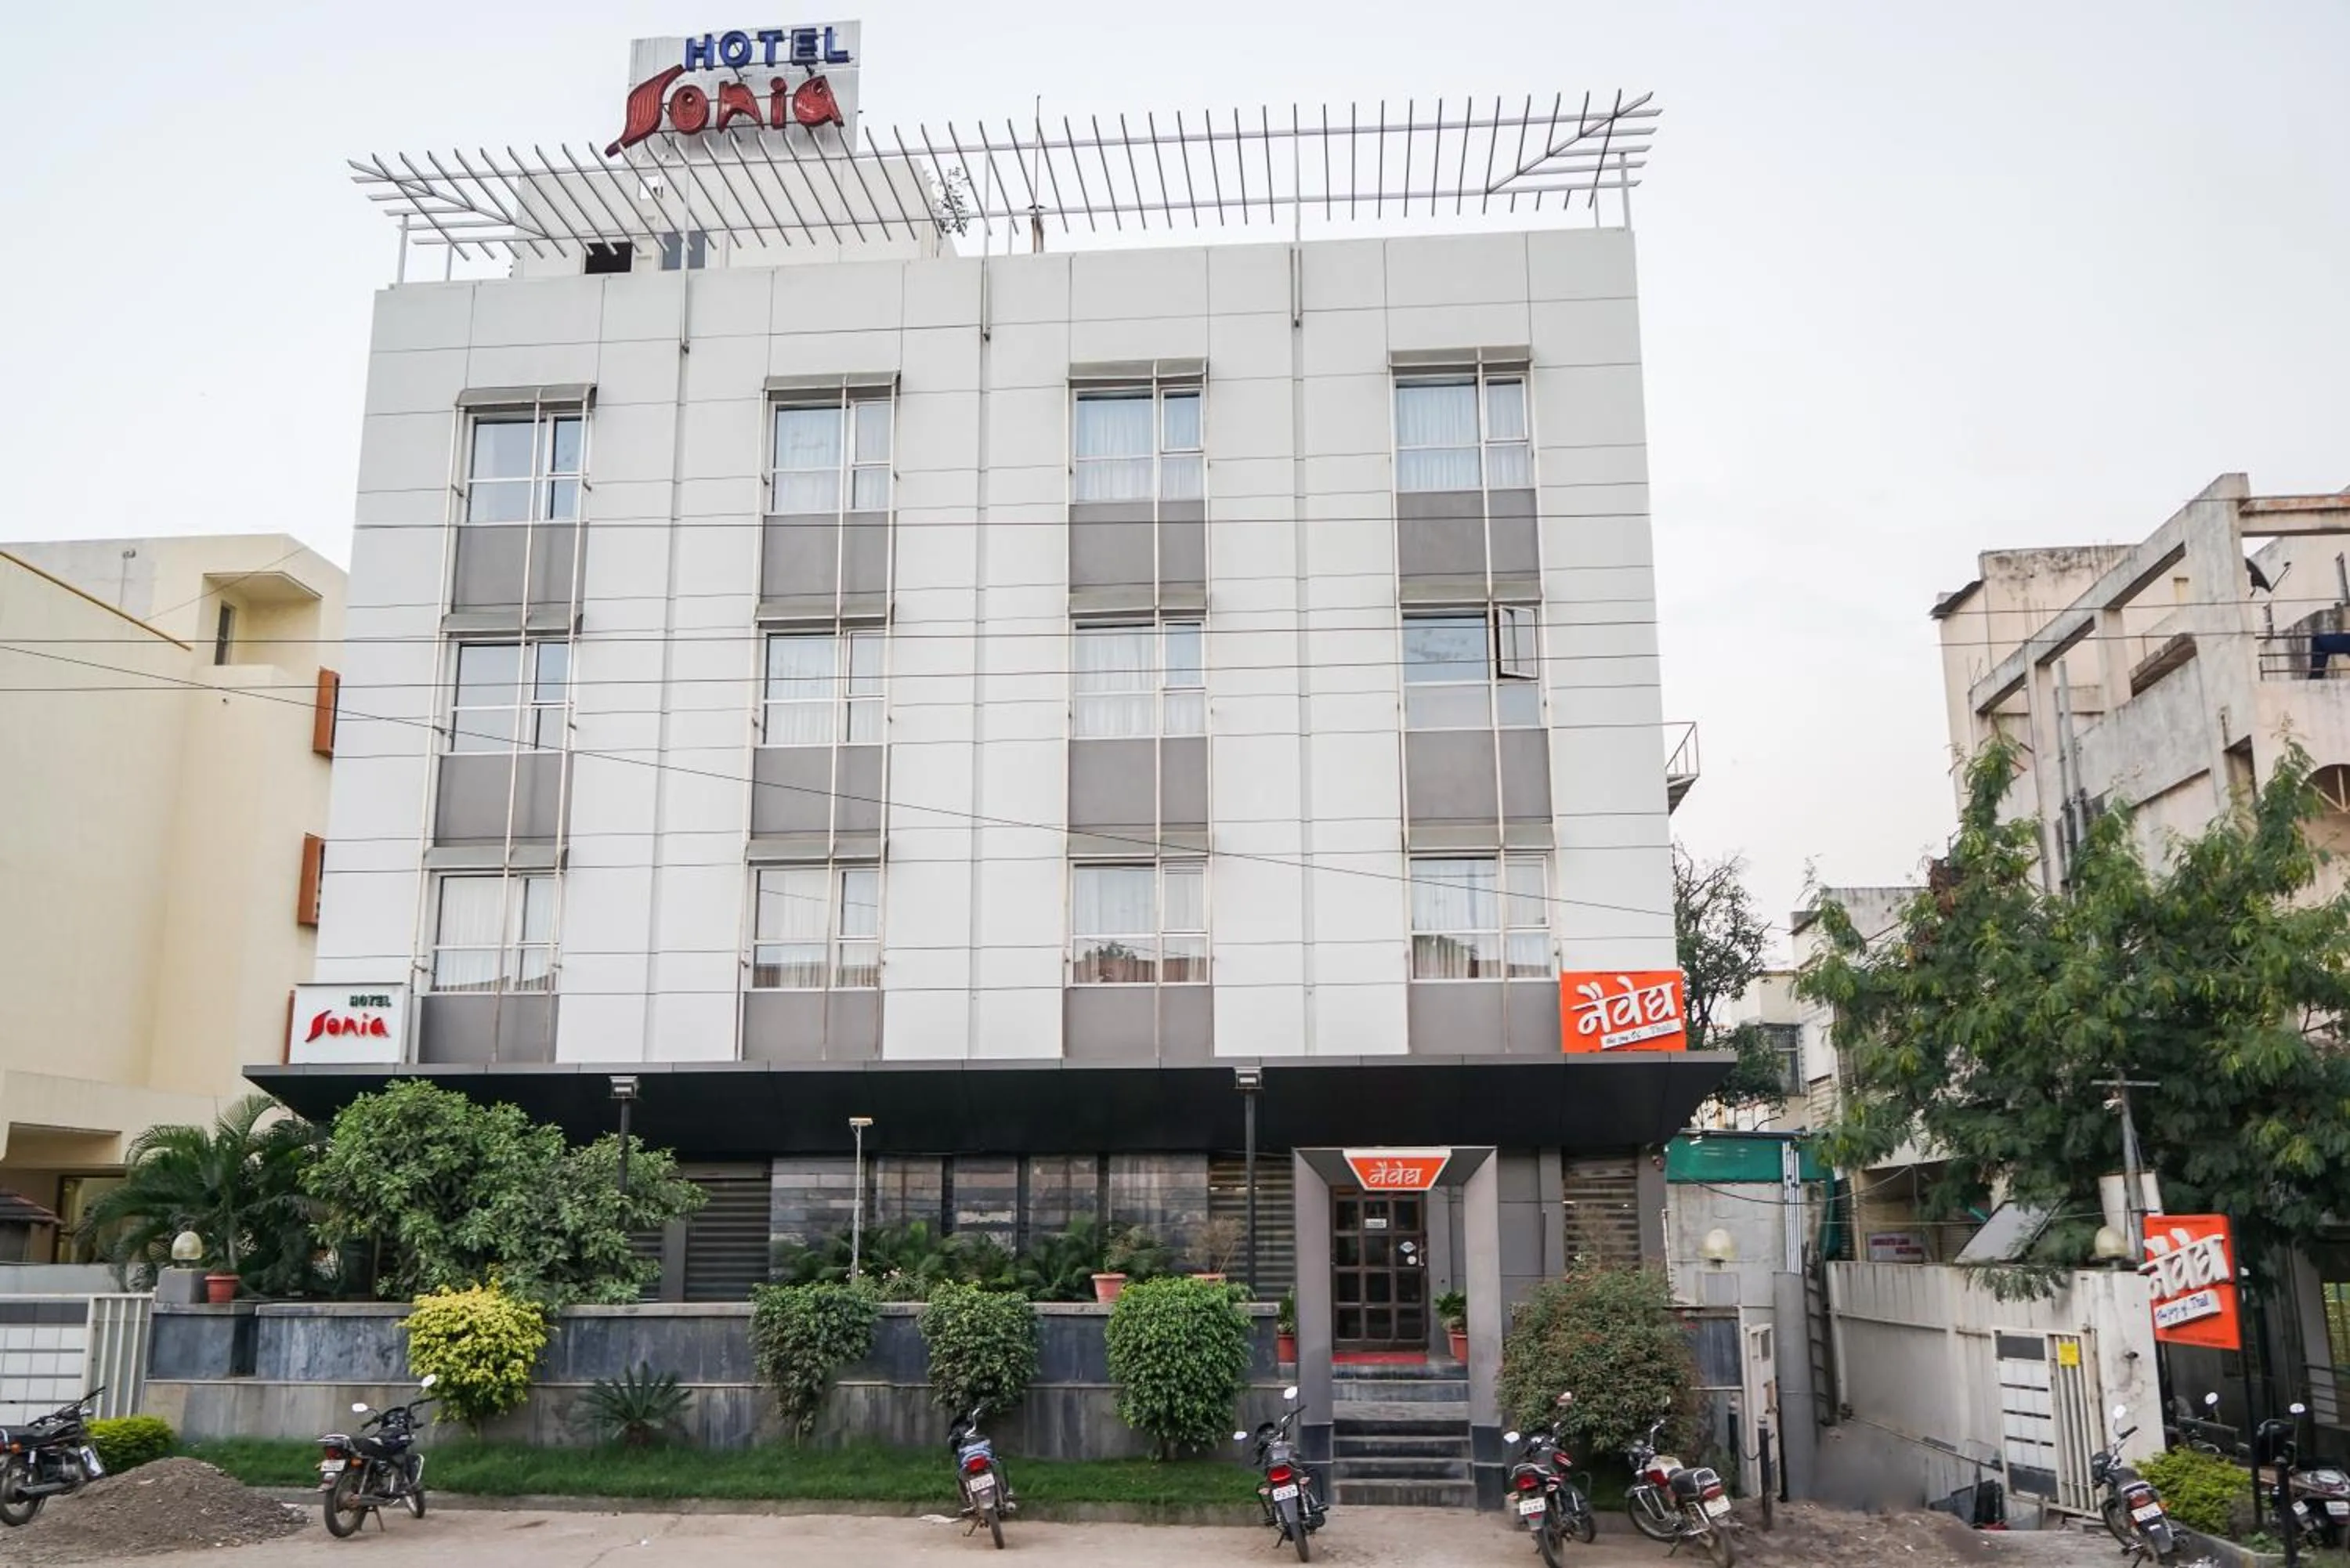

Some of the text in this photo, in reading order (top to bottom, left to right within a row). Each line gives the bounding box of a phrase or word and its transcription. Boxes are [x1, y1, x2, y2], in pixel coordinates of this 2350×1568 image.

[685, 27, 851, 71] HOTEL
[605, 64, 844, 157] Sonia
[349, 994, 392, 1007] HOTEL
[305, 1010, 390, 1042] Sonia
